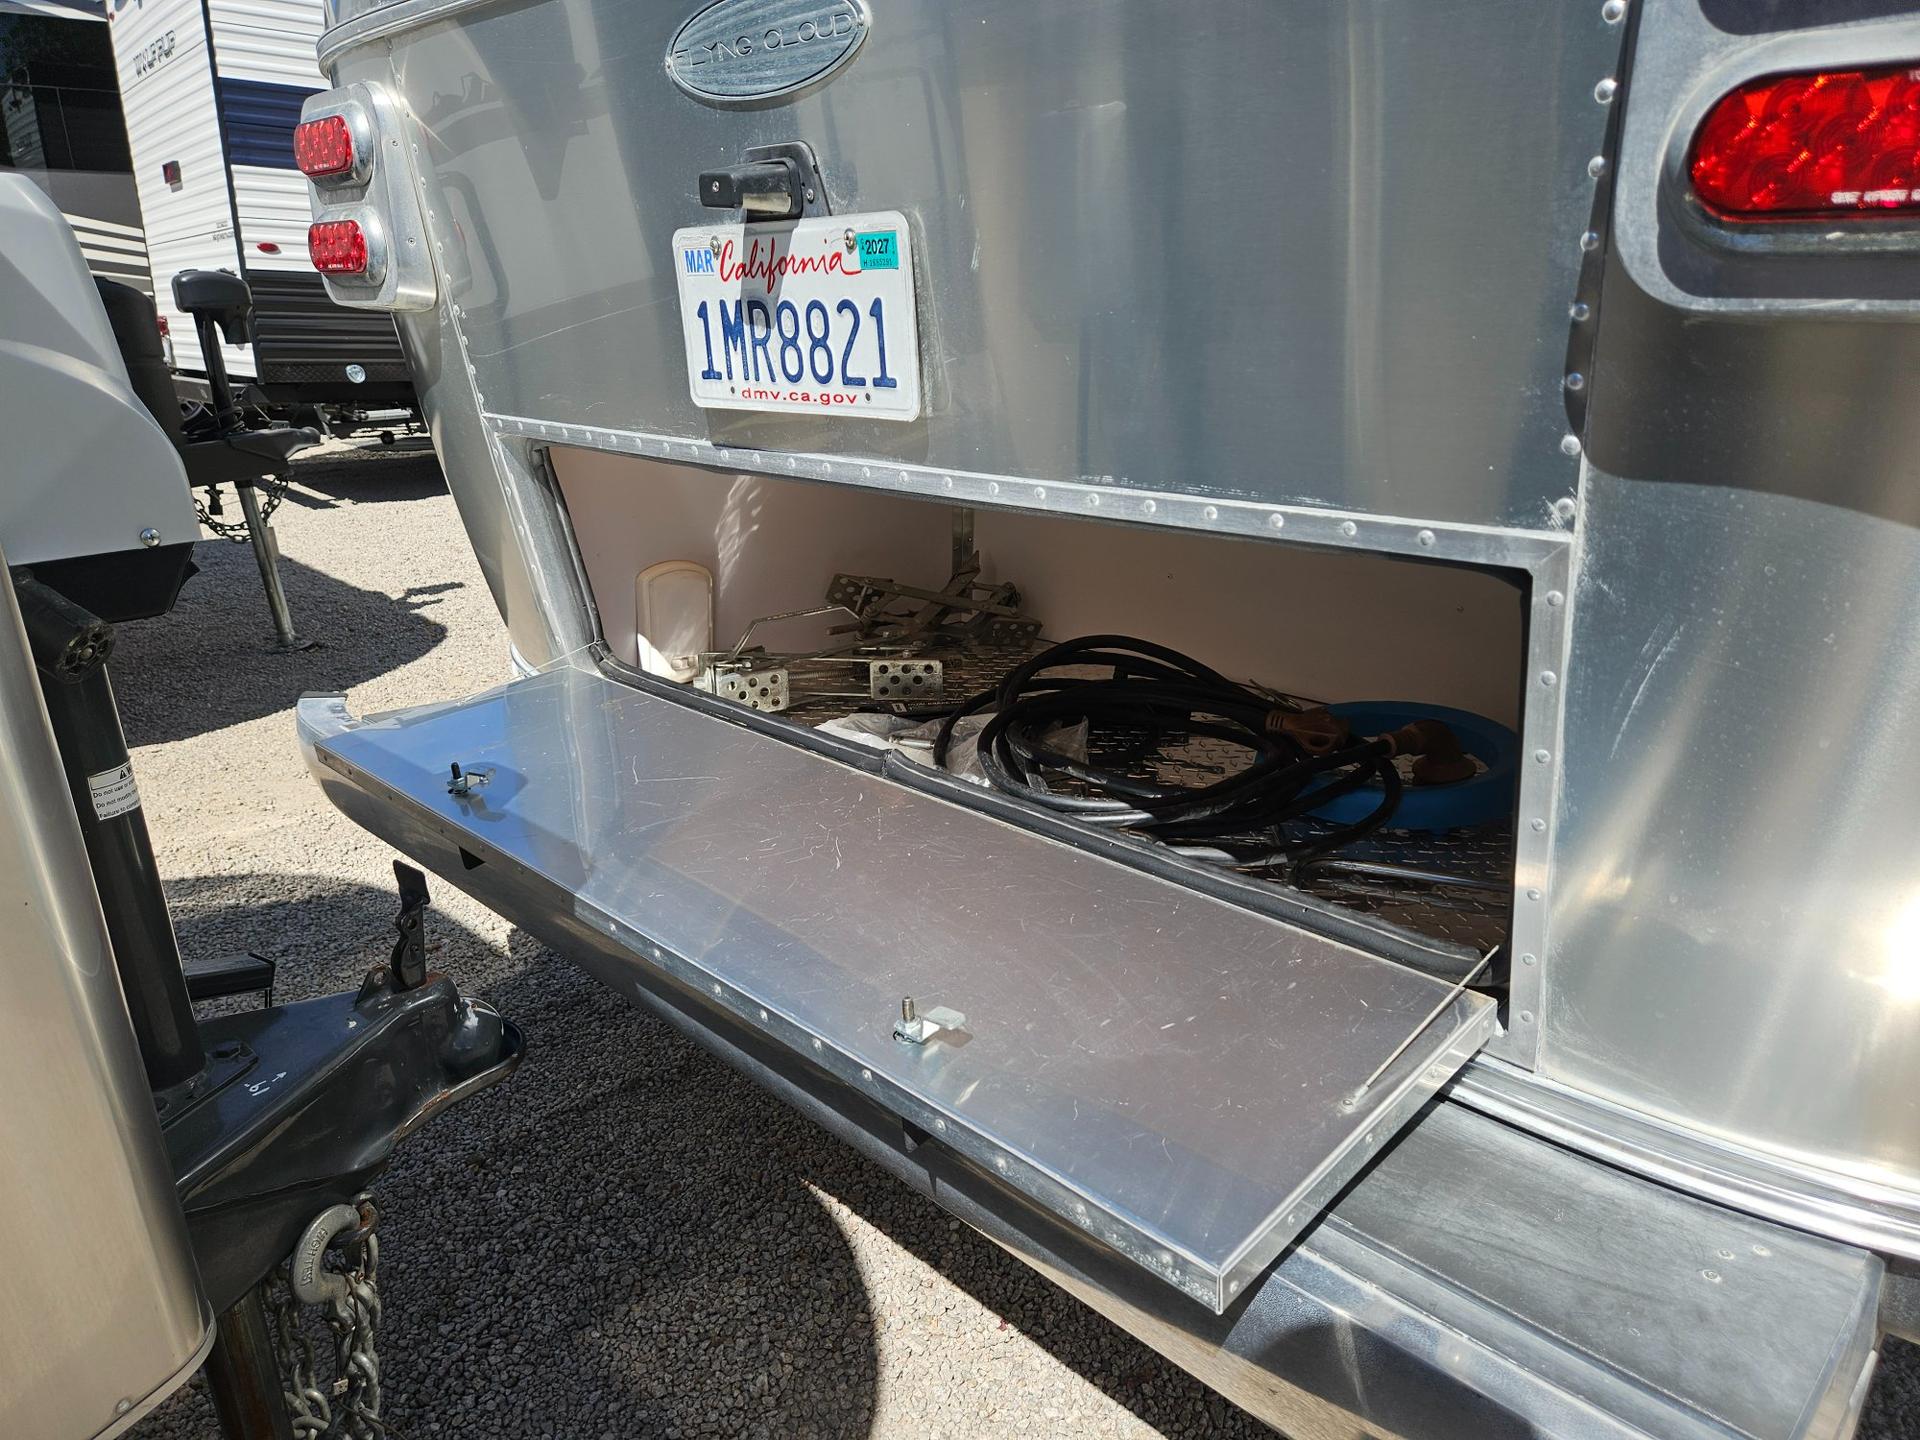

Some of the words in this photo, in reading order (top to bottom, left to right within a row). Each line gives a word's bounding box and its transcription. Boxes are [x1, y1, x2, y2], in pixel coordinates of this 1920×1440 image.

[763, 13, 852, 50] CLOUD
[685, 249, 714, 273] MAR
[865, 238, 889, 255] 2027
[720, 237, 862, 294] California
[697, 297, 897, 388] 1MR8821
[741, 387, 857, 405] dmv.ca.gov
